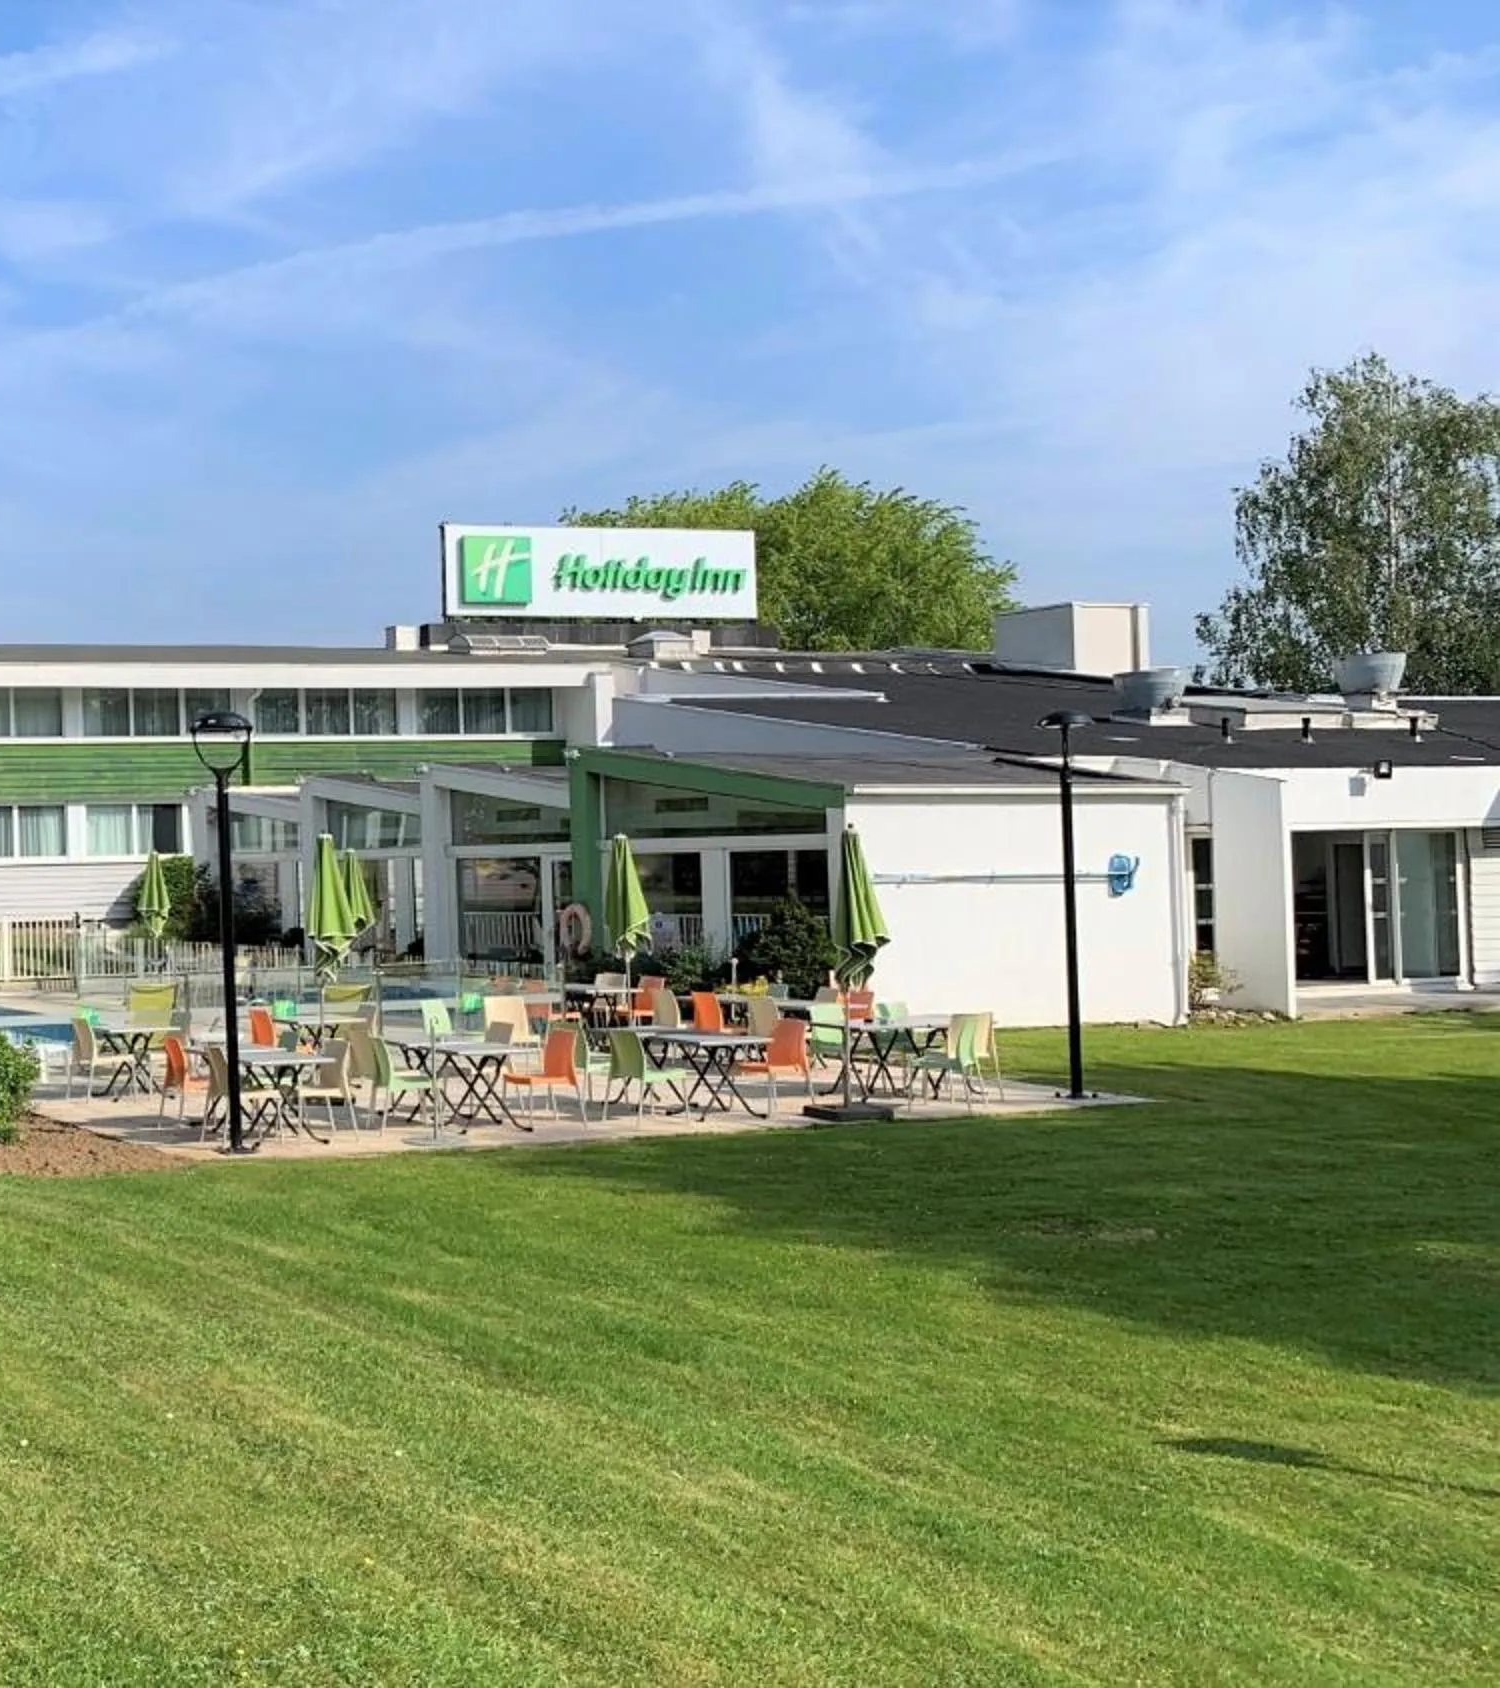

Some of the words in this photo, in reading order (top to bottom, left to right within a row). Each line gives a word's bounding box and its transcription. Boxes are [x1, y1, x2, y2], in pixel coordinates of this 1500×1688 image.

[472, 538, 530, 600] H
[552, 553, 687, 601] Holiday
[688, 556, 747, 595] Inn
